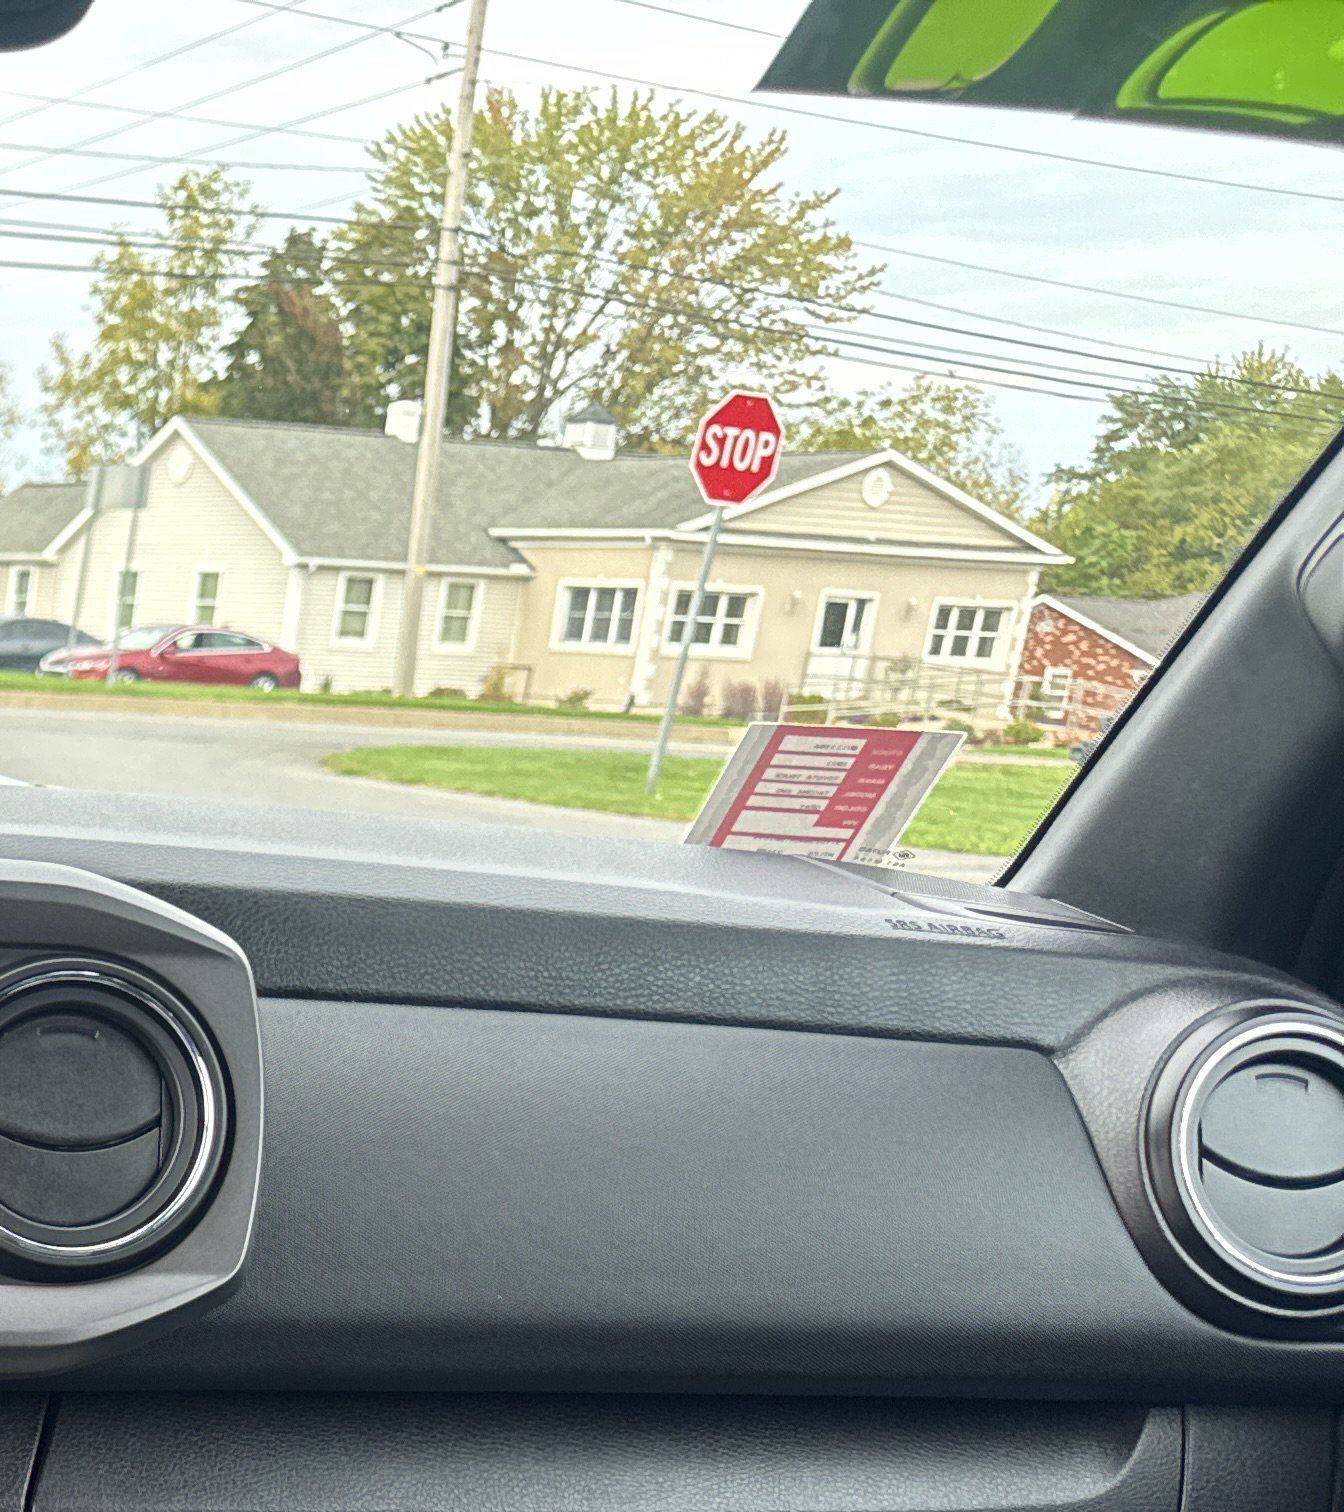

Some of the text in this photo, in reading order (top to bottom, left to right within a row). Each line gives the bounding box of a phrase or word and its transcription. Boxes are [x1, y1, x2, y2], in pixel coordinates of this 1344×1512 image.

[699, 423, 776, 474] STOP
[885, 919, 1007, 939] SRS AIRBAG
